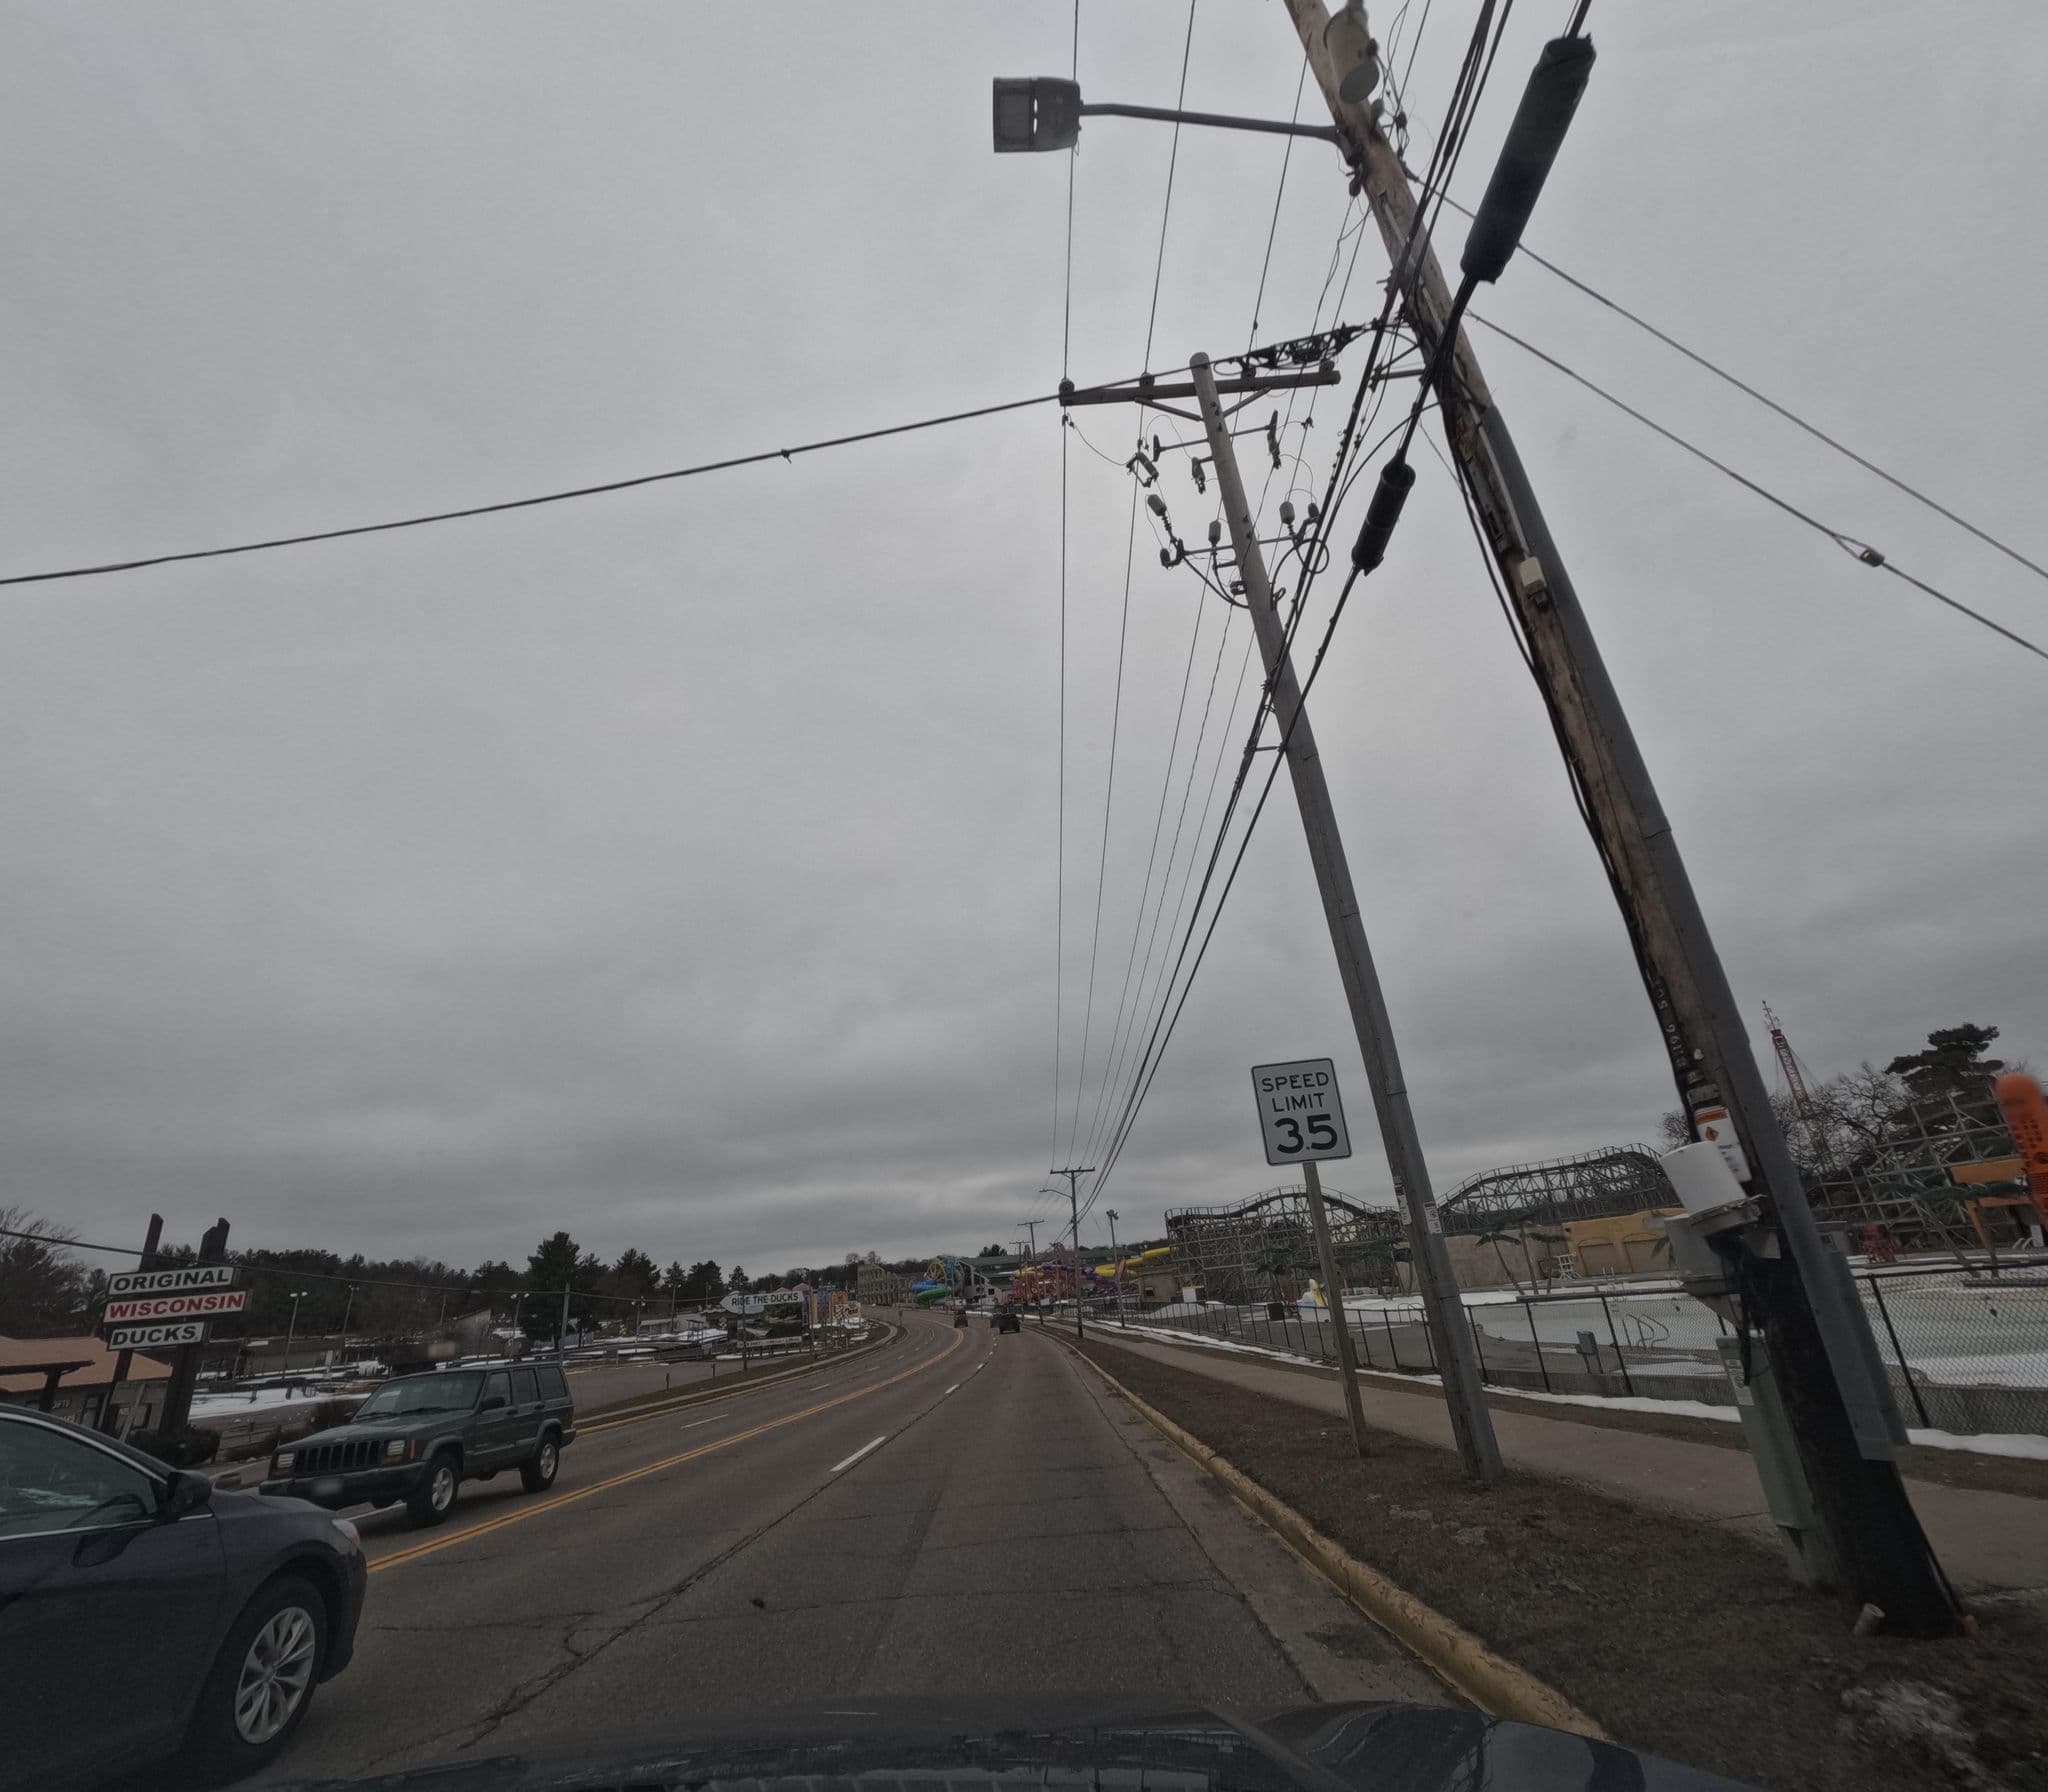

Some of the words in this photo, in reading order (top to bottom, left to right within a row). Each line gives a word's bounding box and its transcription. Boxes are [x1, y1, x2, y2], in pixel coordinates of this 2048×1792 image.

[1261, 1072, 1329, 1092] SPEED
[1272, 1092, 1325, 1112] LIMIT
[1274, 1113, 1338, 1154] 35
[114, 1269, 229, 1291] ORIGINAL
[109, 1294, 244, 1318] WISCONSIN
[731, 1297, 751, 1306] RIDE
[752, 1295, 769, 1304] THE
[770, 1292, 799, 1303] DUCKS
[112, 1325, 196, 1345] DUCKS
